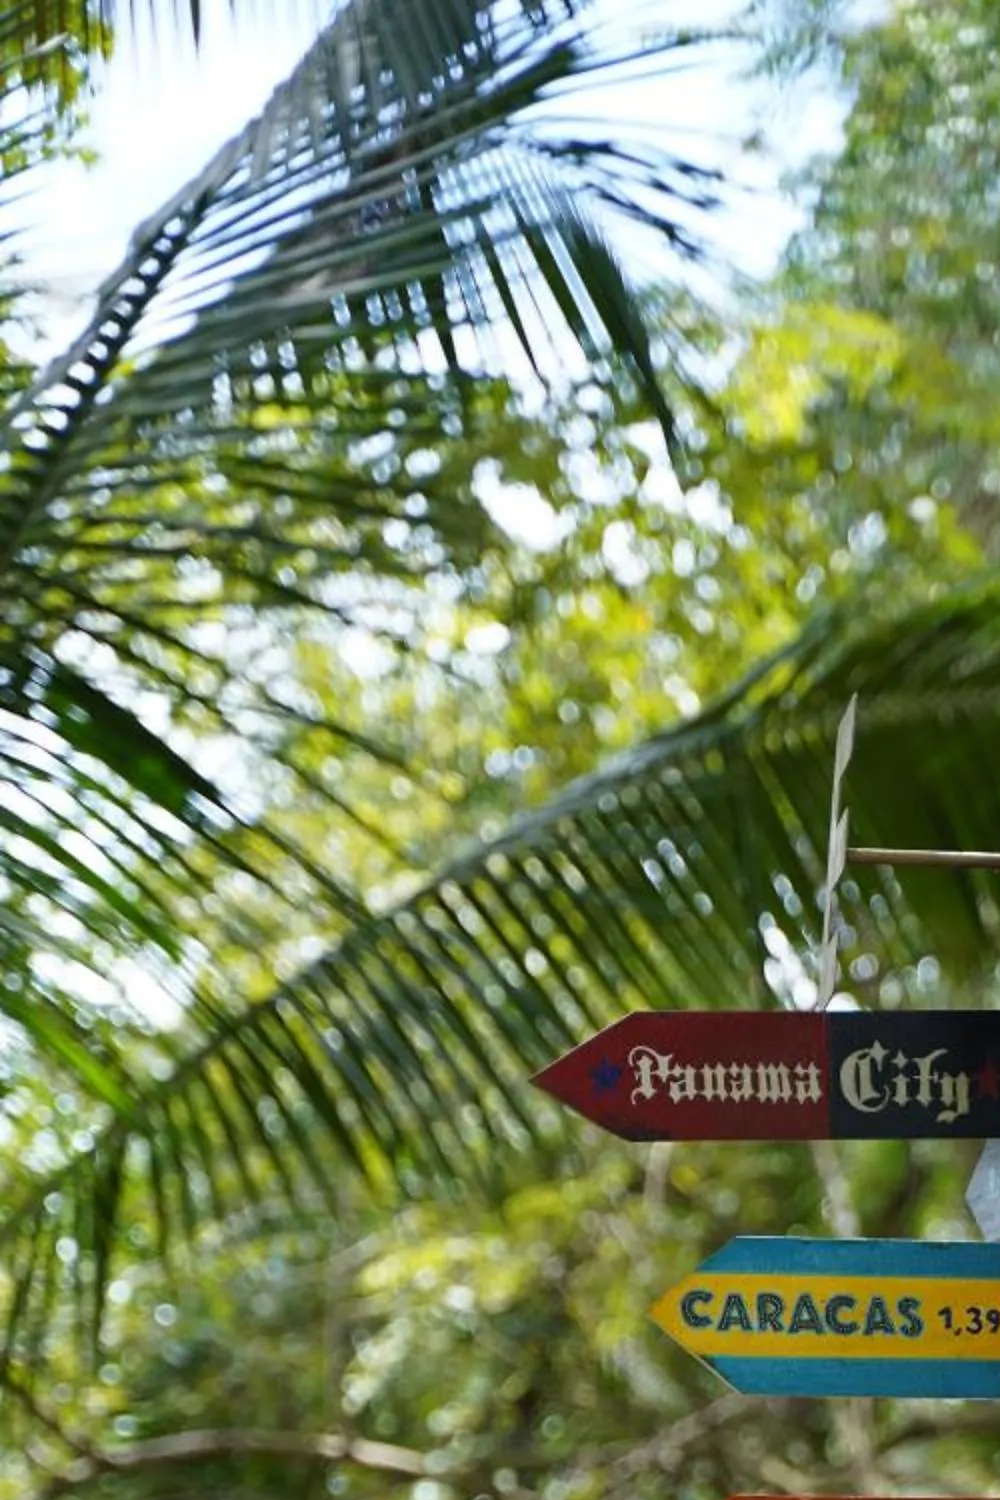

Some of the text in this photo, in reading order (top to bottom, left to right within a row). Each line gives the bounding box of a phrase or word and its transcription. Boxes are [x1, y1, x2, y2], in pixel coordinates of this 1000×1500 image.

[626, 1044, 822, 1105] Panama
[838, 1040, 972, 1123] City
[679, 1290, 925, 1338] CARACAS
